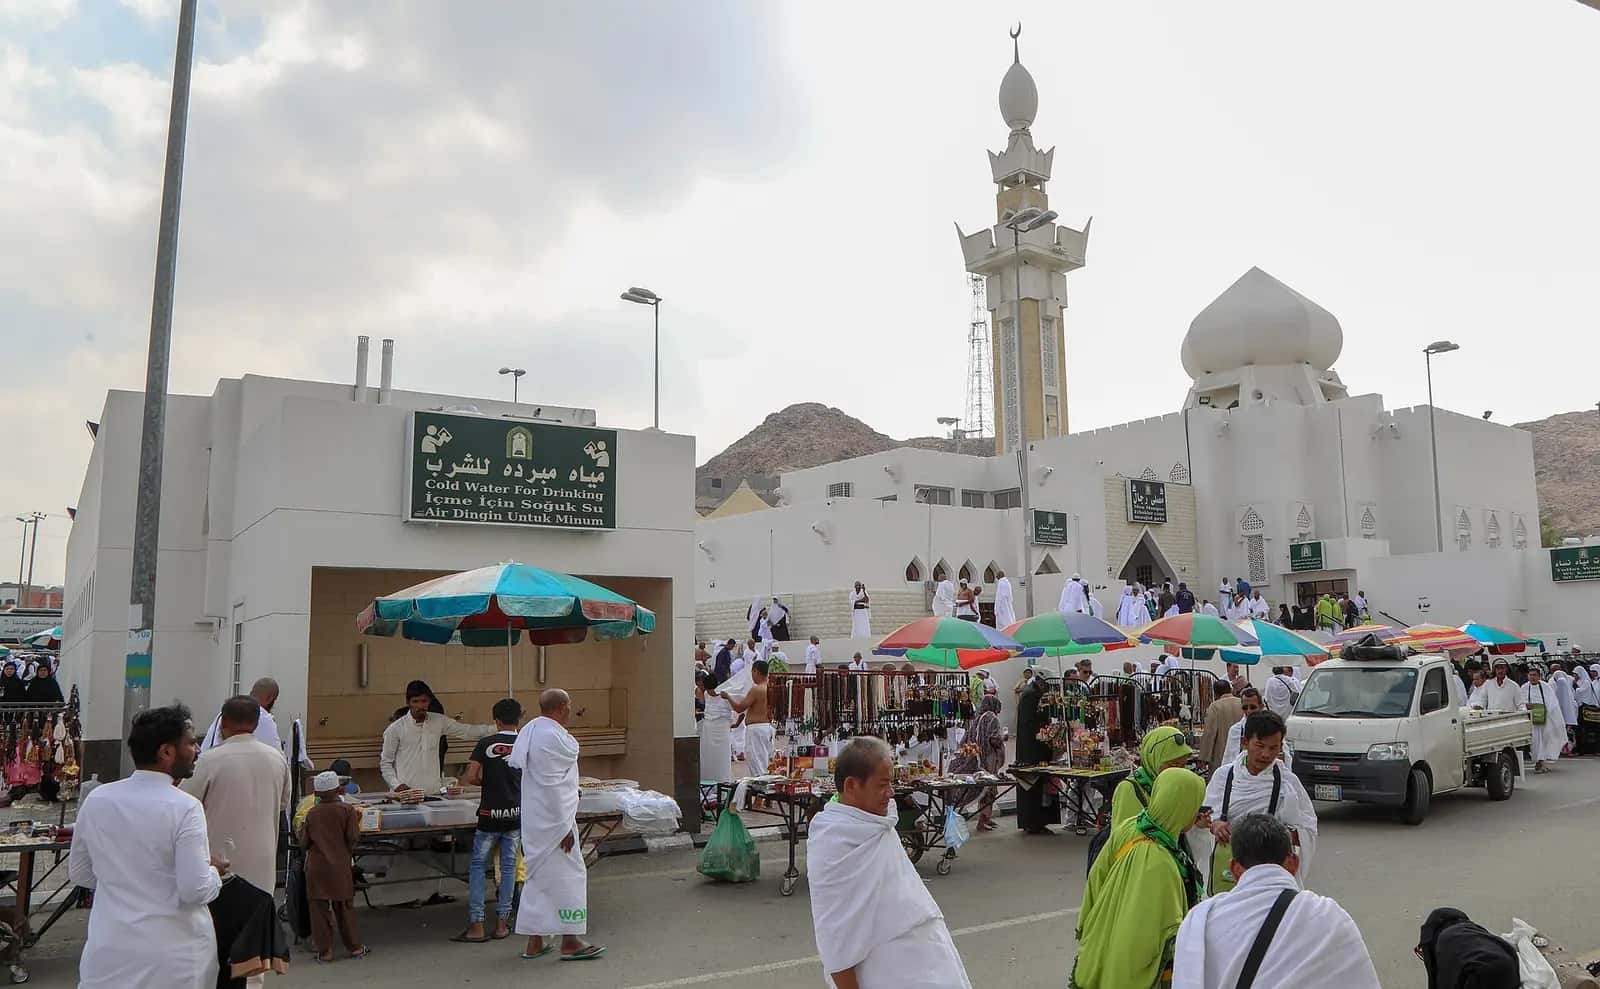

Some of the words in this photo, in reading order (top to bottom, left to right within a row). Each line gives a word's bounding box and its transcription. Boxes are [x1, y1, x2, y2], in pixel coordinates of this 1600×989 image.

[426, 453, 490, 477] للشرب
[503, 463, 557, 484] مبرده
[569, 464, 605, 488] مياه
[425, 479, 459, 490] Cold
[465, 482, 510, 494] Water
[514, 485, 538, 496] For
[543, 487, 604, 501] Drinking
[425, 491, 473, 506] İçme
[479, 493, 514, 509] İçin
[521, 499, 576, 513] Soğuk
[581, 503, 603, 513] Su
[424, 507, 448, 518] Air
[453, 509, 502, 522] Dingin
[508, 511, 551, 523] Untuk
[555, 515, 603, 526] Minum
